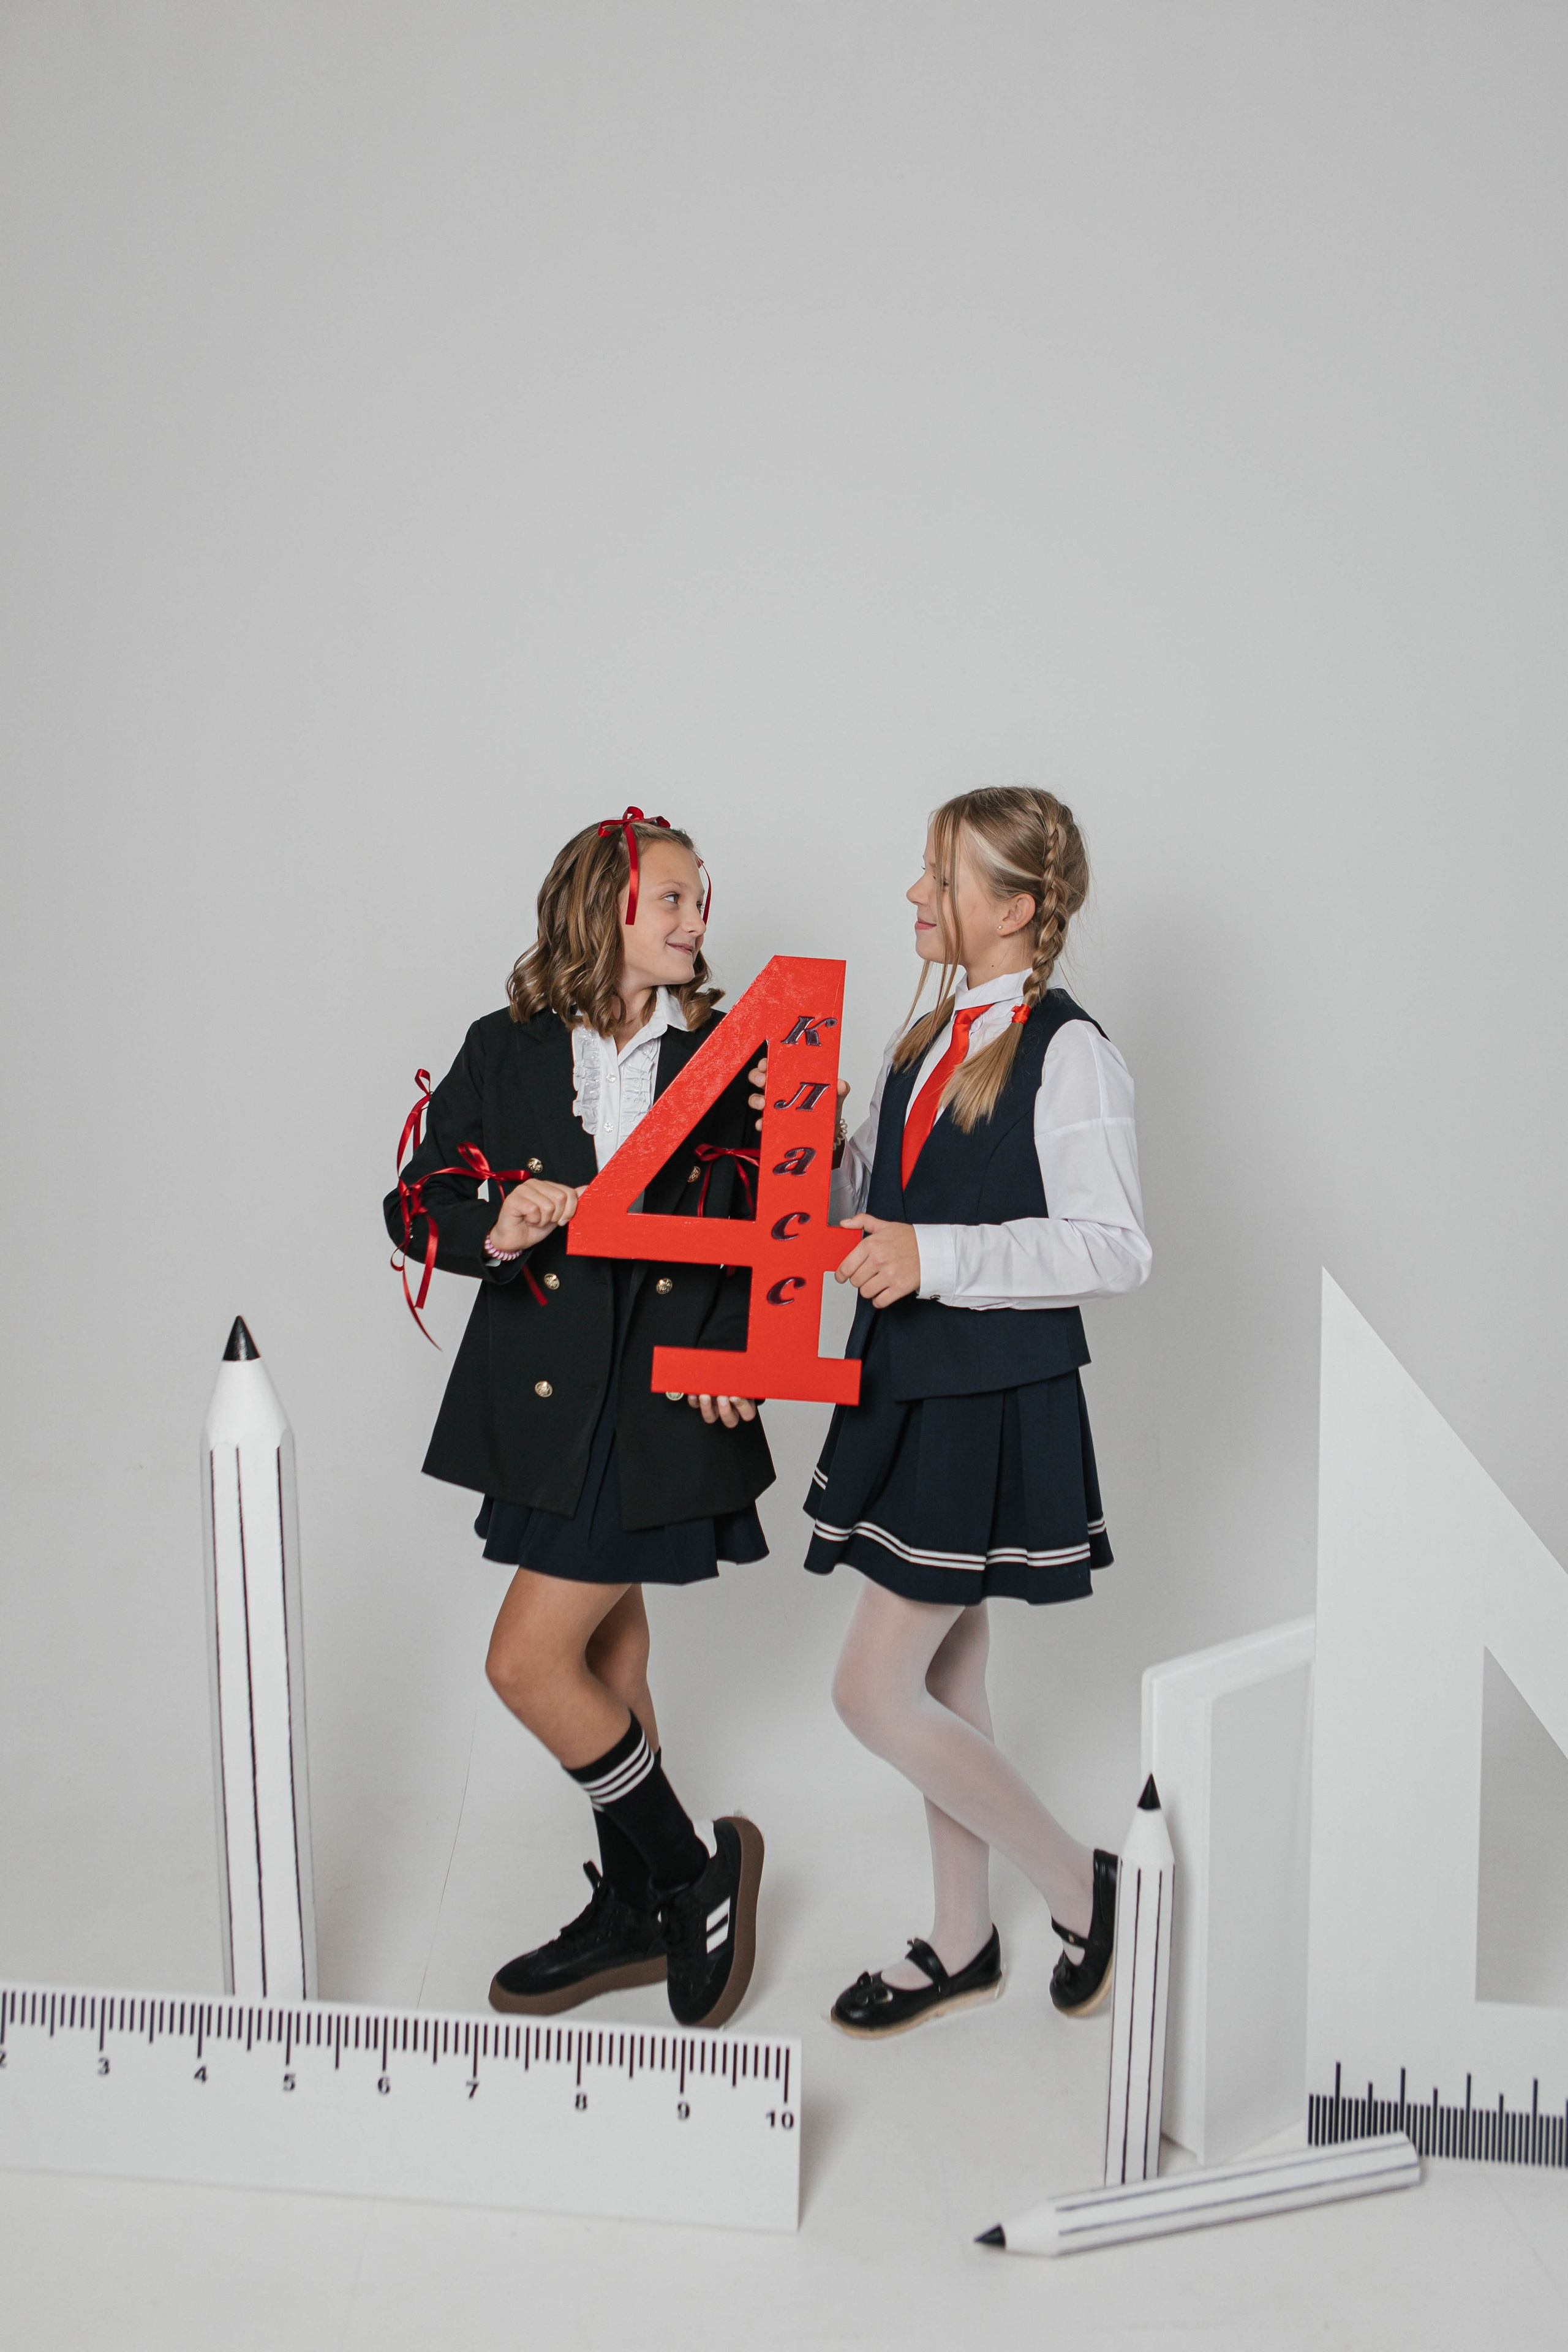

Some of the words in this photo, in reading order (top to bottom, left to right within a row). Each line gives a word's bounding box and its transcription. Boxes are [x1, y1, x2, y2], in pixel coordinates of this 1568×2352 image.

[566, 955, 863, 1406] 4
[766, 1015, 838, 1306] класс
[98, 2057, 110, 2076] 3
[194, 2065, 208, 2084] 4
[282, 2073, 296, 2092] 5
[377, 2076, 391, 2095] 6
[466, 2080, 479, 2099] 7
[575, 2092, 588, 2111] 8
[677, 2101, 690, 2120] 9
[766, 2110, 794, 2130] 10
